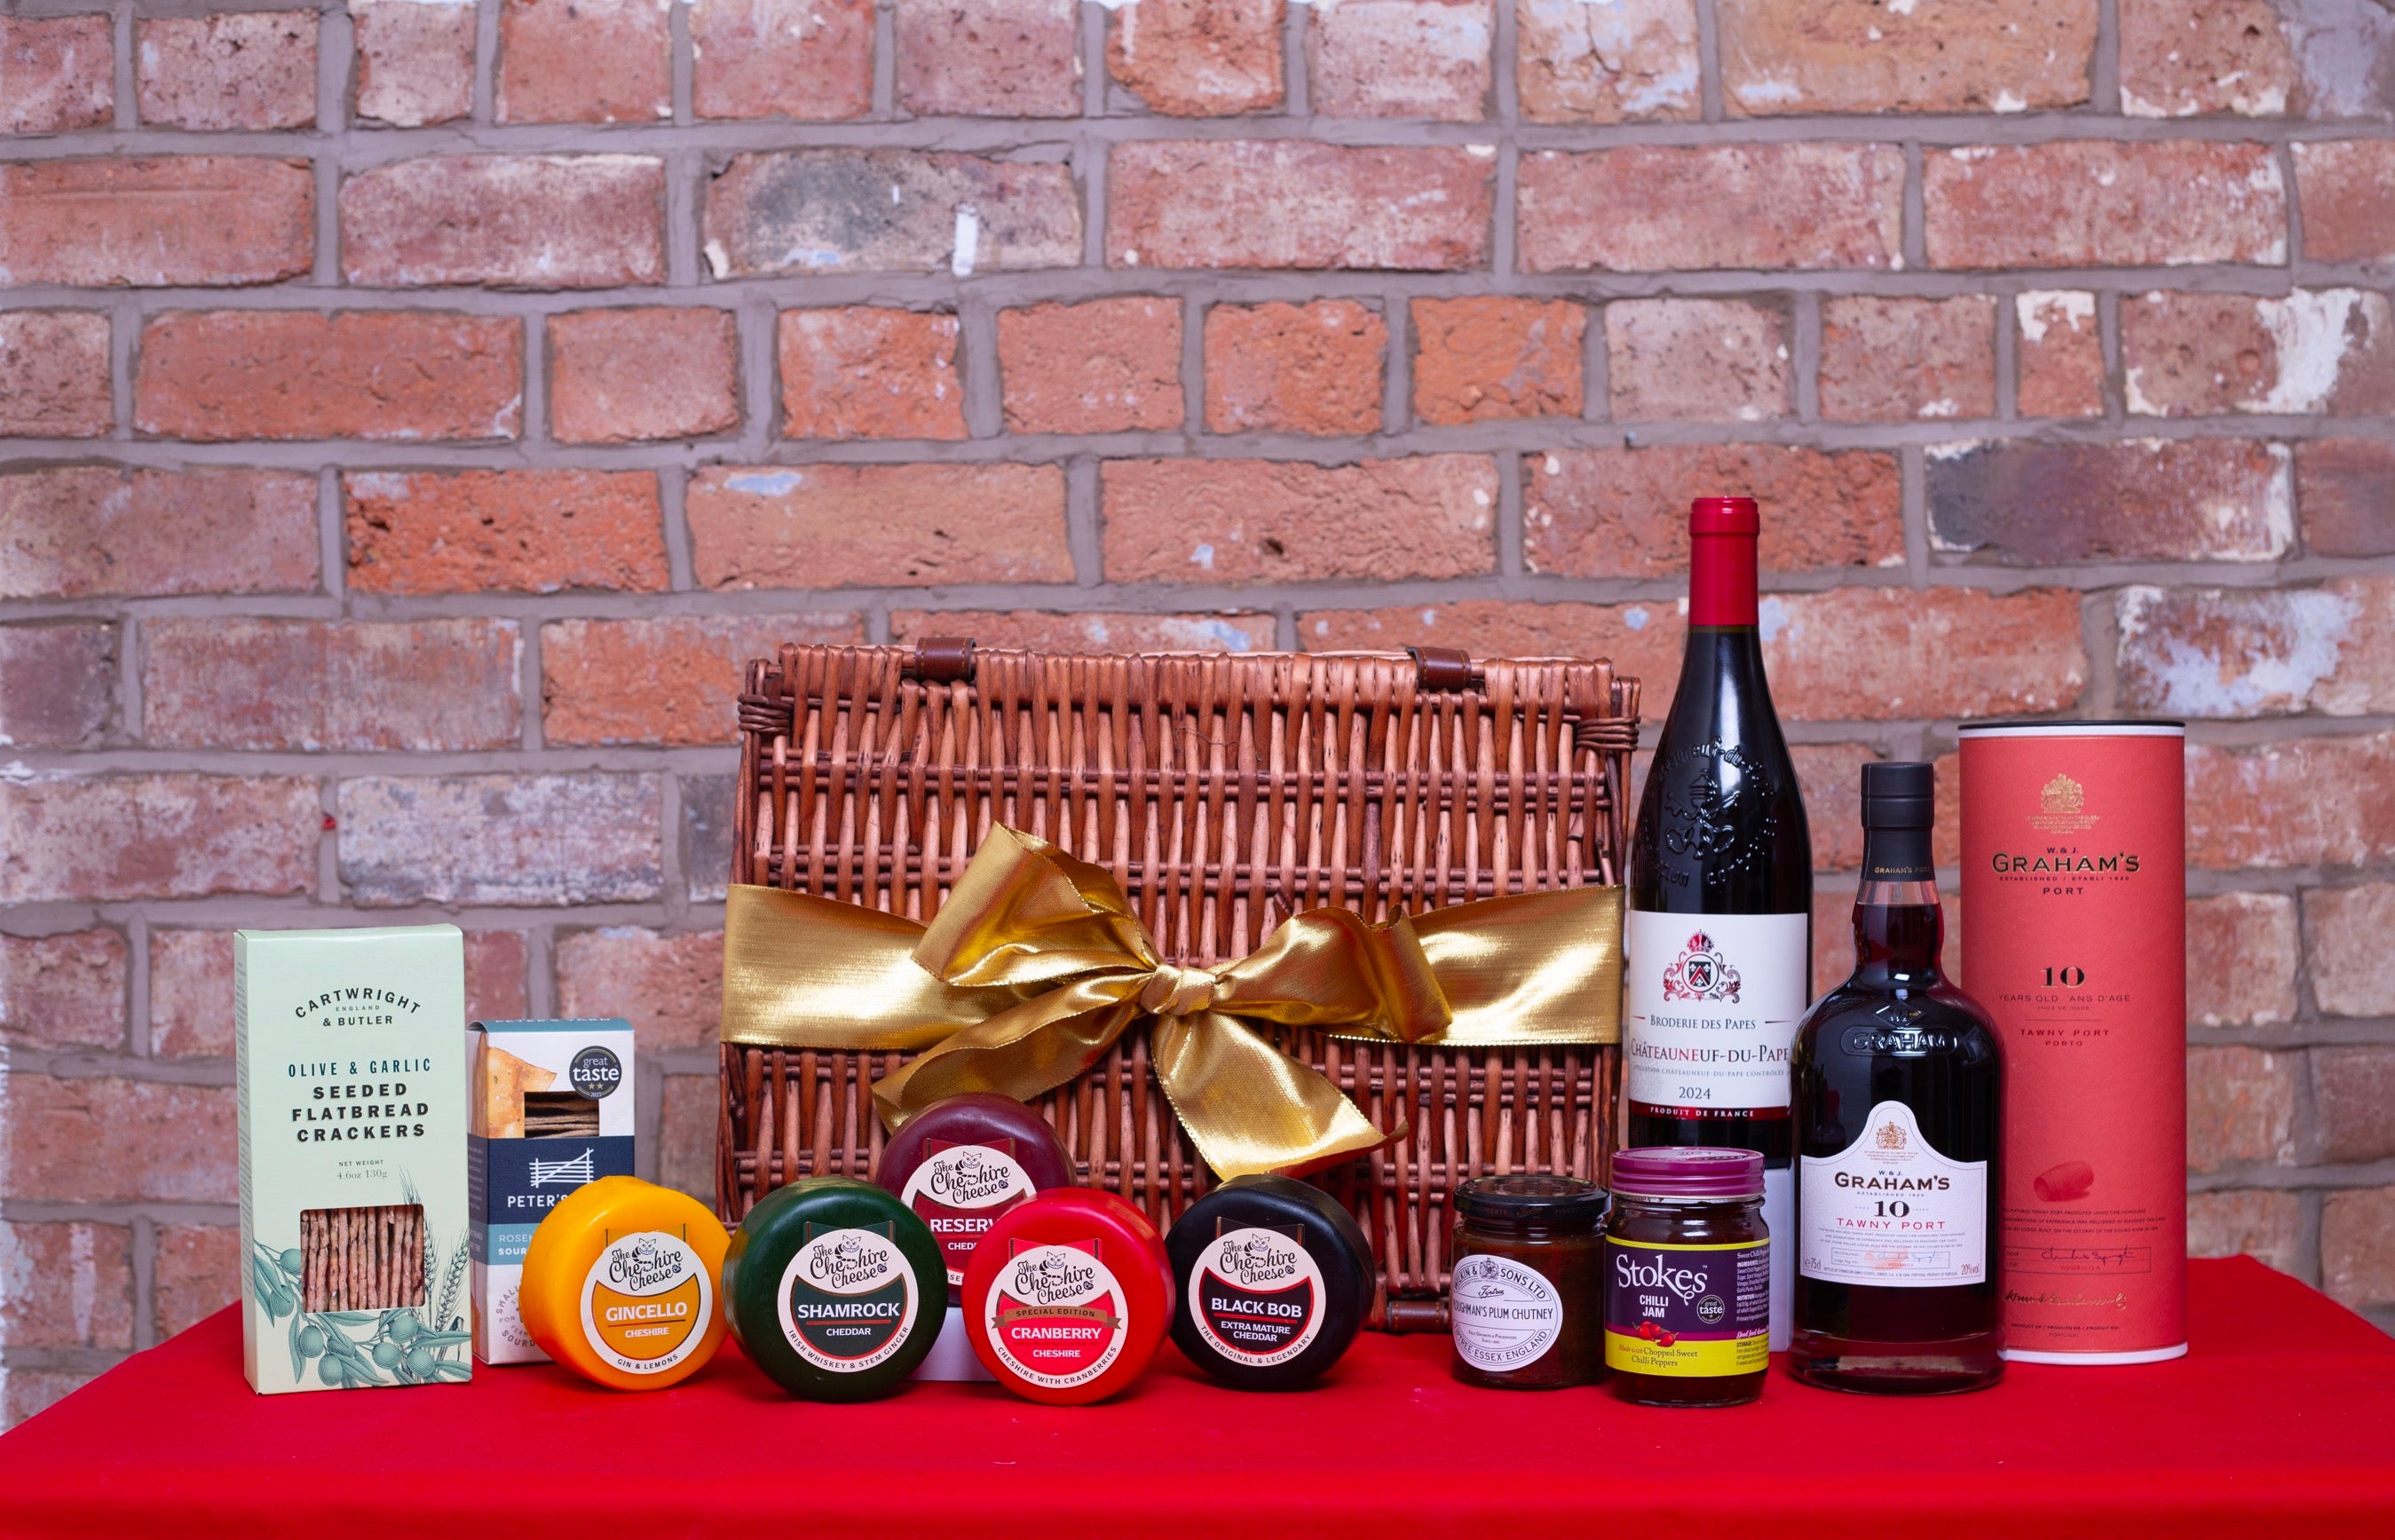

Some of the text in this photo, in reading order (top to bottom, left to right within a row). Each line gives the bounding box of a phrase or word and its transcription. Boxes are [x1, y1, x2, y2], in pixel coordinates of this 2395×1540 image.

[1992, 852, 2140, 873] GRAHAM'S
[2041, 966, 2085, 988] 10
[295, 987, 421, 1018] CARTWRIGHT
[323, 1015, 393, 1027] & BUTLER
[1651, 1015, 1756, 1030] BRODERIE DES PAPES
[288, 1058, 431, 1078] OLIVE & GARLIC
[583, 1057, 608, 1069] great
[573, 1067, 620, 1081] taste
[312, 1083, 407, 1099] SEEDED
[1679, 1086, 1711, 1100] 2024
[291, 1103, 429, 1121] FLATBREAD
[1650, 1107, 1689, 1116] PRODUIT
[296, 1124, 425, 1143] CRACKERS
[934, 1160, 953, 1173] The
[337, 1169, 388, 1180] 4.6oz 130g
[1834, 1172, 1950, 1190] GRAHAM'S
[952, 1182, 1000, 1204] Cheese
[1874, 1200, 1910, 1218] 10
[1838, 1218, 1946, 1230] TAWNY PORT
[813, 1244, 833, 1258] The
[1223, 1240, 1243, 1254] The
[613, 1249, 630, 1262] The
[1017, 1260, 1038, 1274] The
[630, 1268, 673, 1291] Cheese
[832, 1266, 878, 1289] Cheese
[1240, 1267, 1286, 1285] Cheese
[1473, 1266, 1478, 1275] &
[1500, 1268, 1529, 1286] SONS
[1528, 1282, 1546, 1299] LTD
[1616, 1253, 1708, 1306] Stokes
[1037, 1283, 1084, 1305] Cheese
[1640, 1294, 1669, 1307] CHILLI
[605, 1302, 688, 1322] GINCELLO
[798, 1303, 900, 1319] SHAMROCK
[1016, 1308, 1095, 1317] SPECIAL EDITION
[1211, 1298, 1302, 1318] BLACK BOB
[1490, 1307, 1510, 1320] PLUM
[1512, 1308, 1553, 1320] CHUTNEY
[1642, 1307, 1665, 1318] JAM
[625, 1328, 669, 1338] CHESHIRE
[826, 1328, 872, 1337] CHEDDAR
[1011, 1328, 1103, 1339] CRANBERRY
[1221, 1321, 1291, 1334] EXTRA MATURE
[1201, 1325, 1213, 1342] THE
[1214, 1341, 1253, 1363] ORIGINAL
[1266, 1333, 1311, 1363] LEGENDARY
[1234, 1331, 1277, 1342] CHEDDAR
[788, 1330, 806, 1353] IRISH
[808, 1352, 847, 1369] WHISKEY
[859, 1354, 882, 1368] STEM
[884, 1326, 909, 1355] GINGER
[1033, 1349, 1081, 1358] CHESHIRE
[1474, 1348, 1503, 1362] ESSEX
[1506, 1331, 1547, 1360] ENGLAND
[1644, 1347, 1675, 1357] Chopped
[618, 1358, 632, 1368] GIN
[644, 1354, 678, 1370] LEMONS
[998, 1346, 1117, 1385] CHESHIRE WITH CRANBERRIES
[1632, 1355, 1678, 1368] Chilli Peppers
